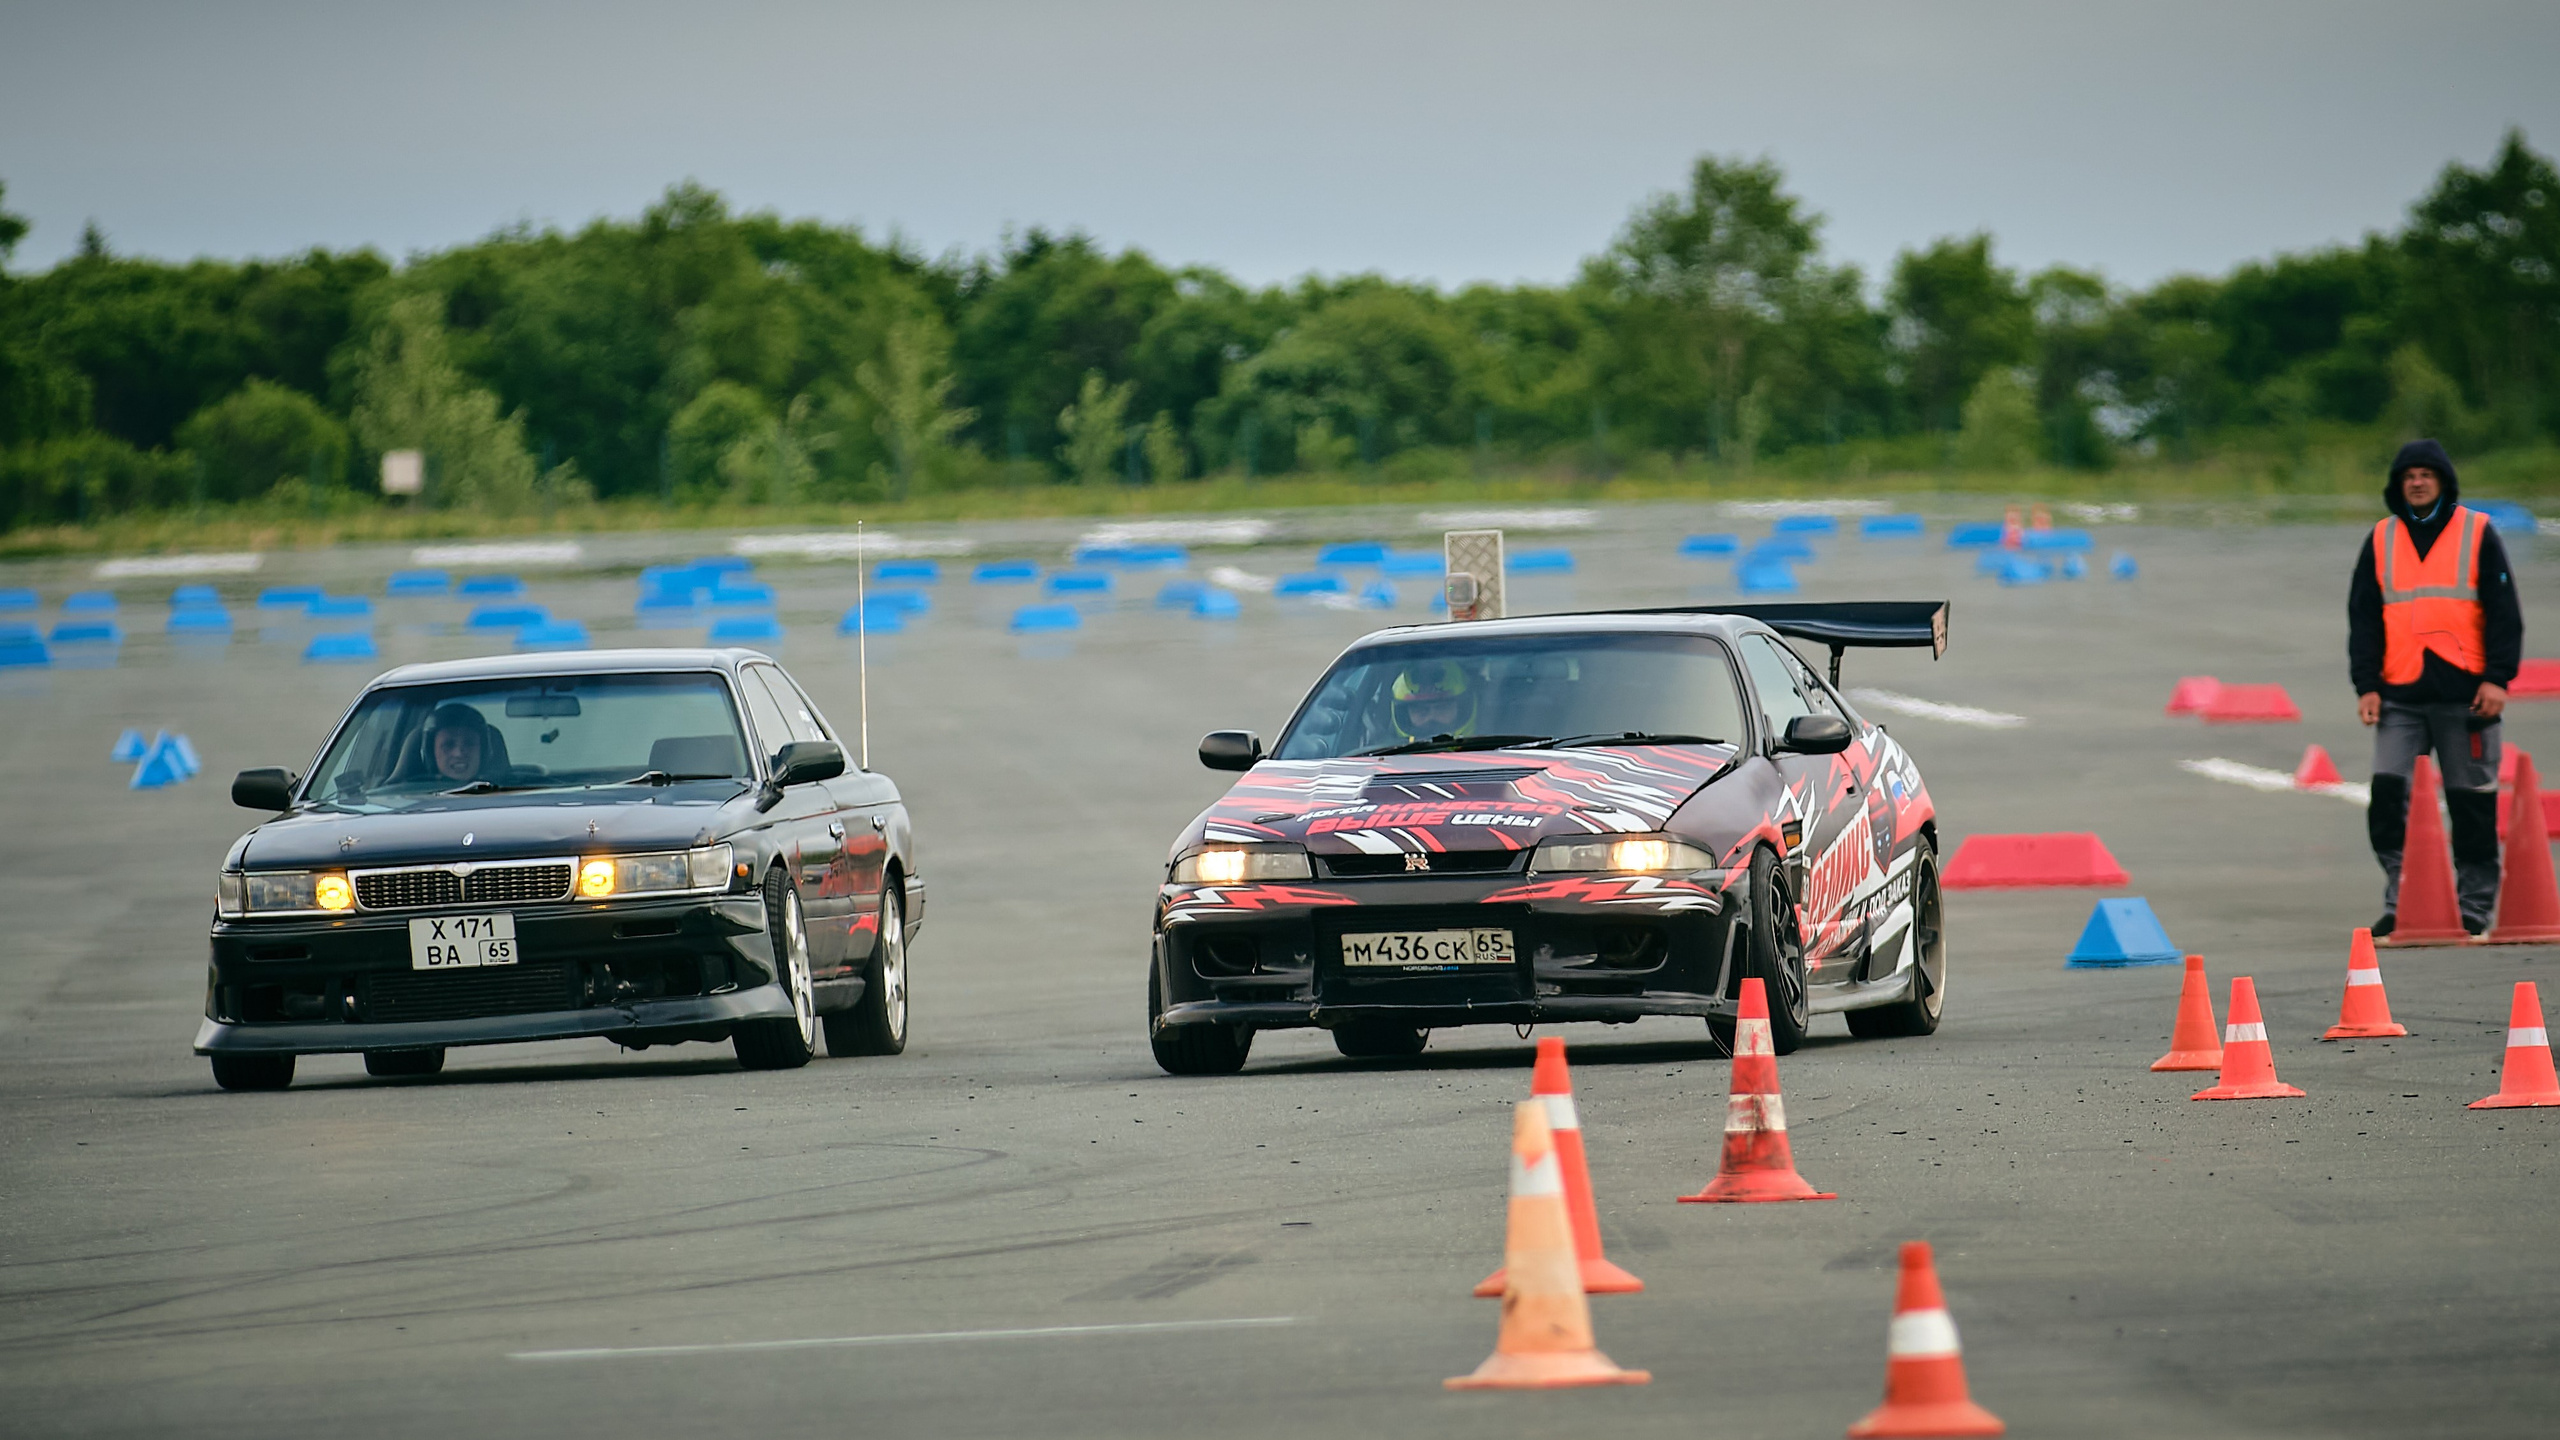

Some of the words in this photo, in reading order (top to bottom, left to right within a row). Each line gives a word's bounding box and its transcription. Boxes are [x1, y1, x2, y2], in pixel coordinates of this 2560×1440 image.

[1305, 811, 1451, 836] ВЫШЕ
[1450, 813, 1544, 828] ЦЕНЫ
[1888, 869, 1912, 908] ЗАКАЗ
[454, 917, 494, 939] 171
[427, 944, 462, 966] ВА
[489, 942, 510, 957] 65
[1476, 933, 1504, 953] 65
[1475, 953, 1496, 961] RUS
